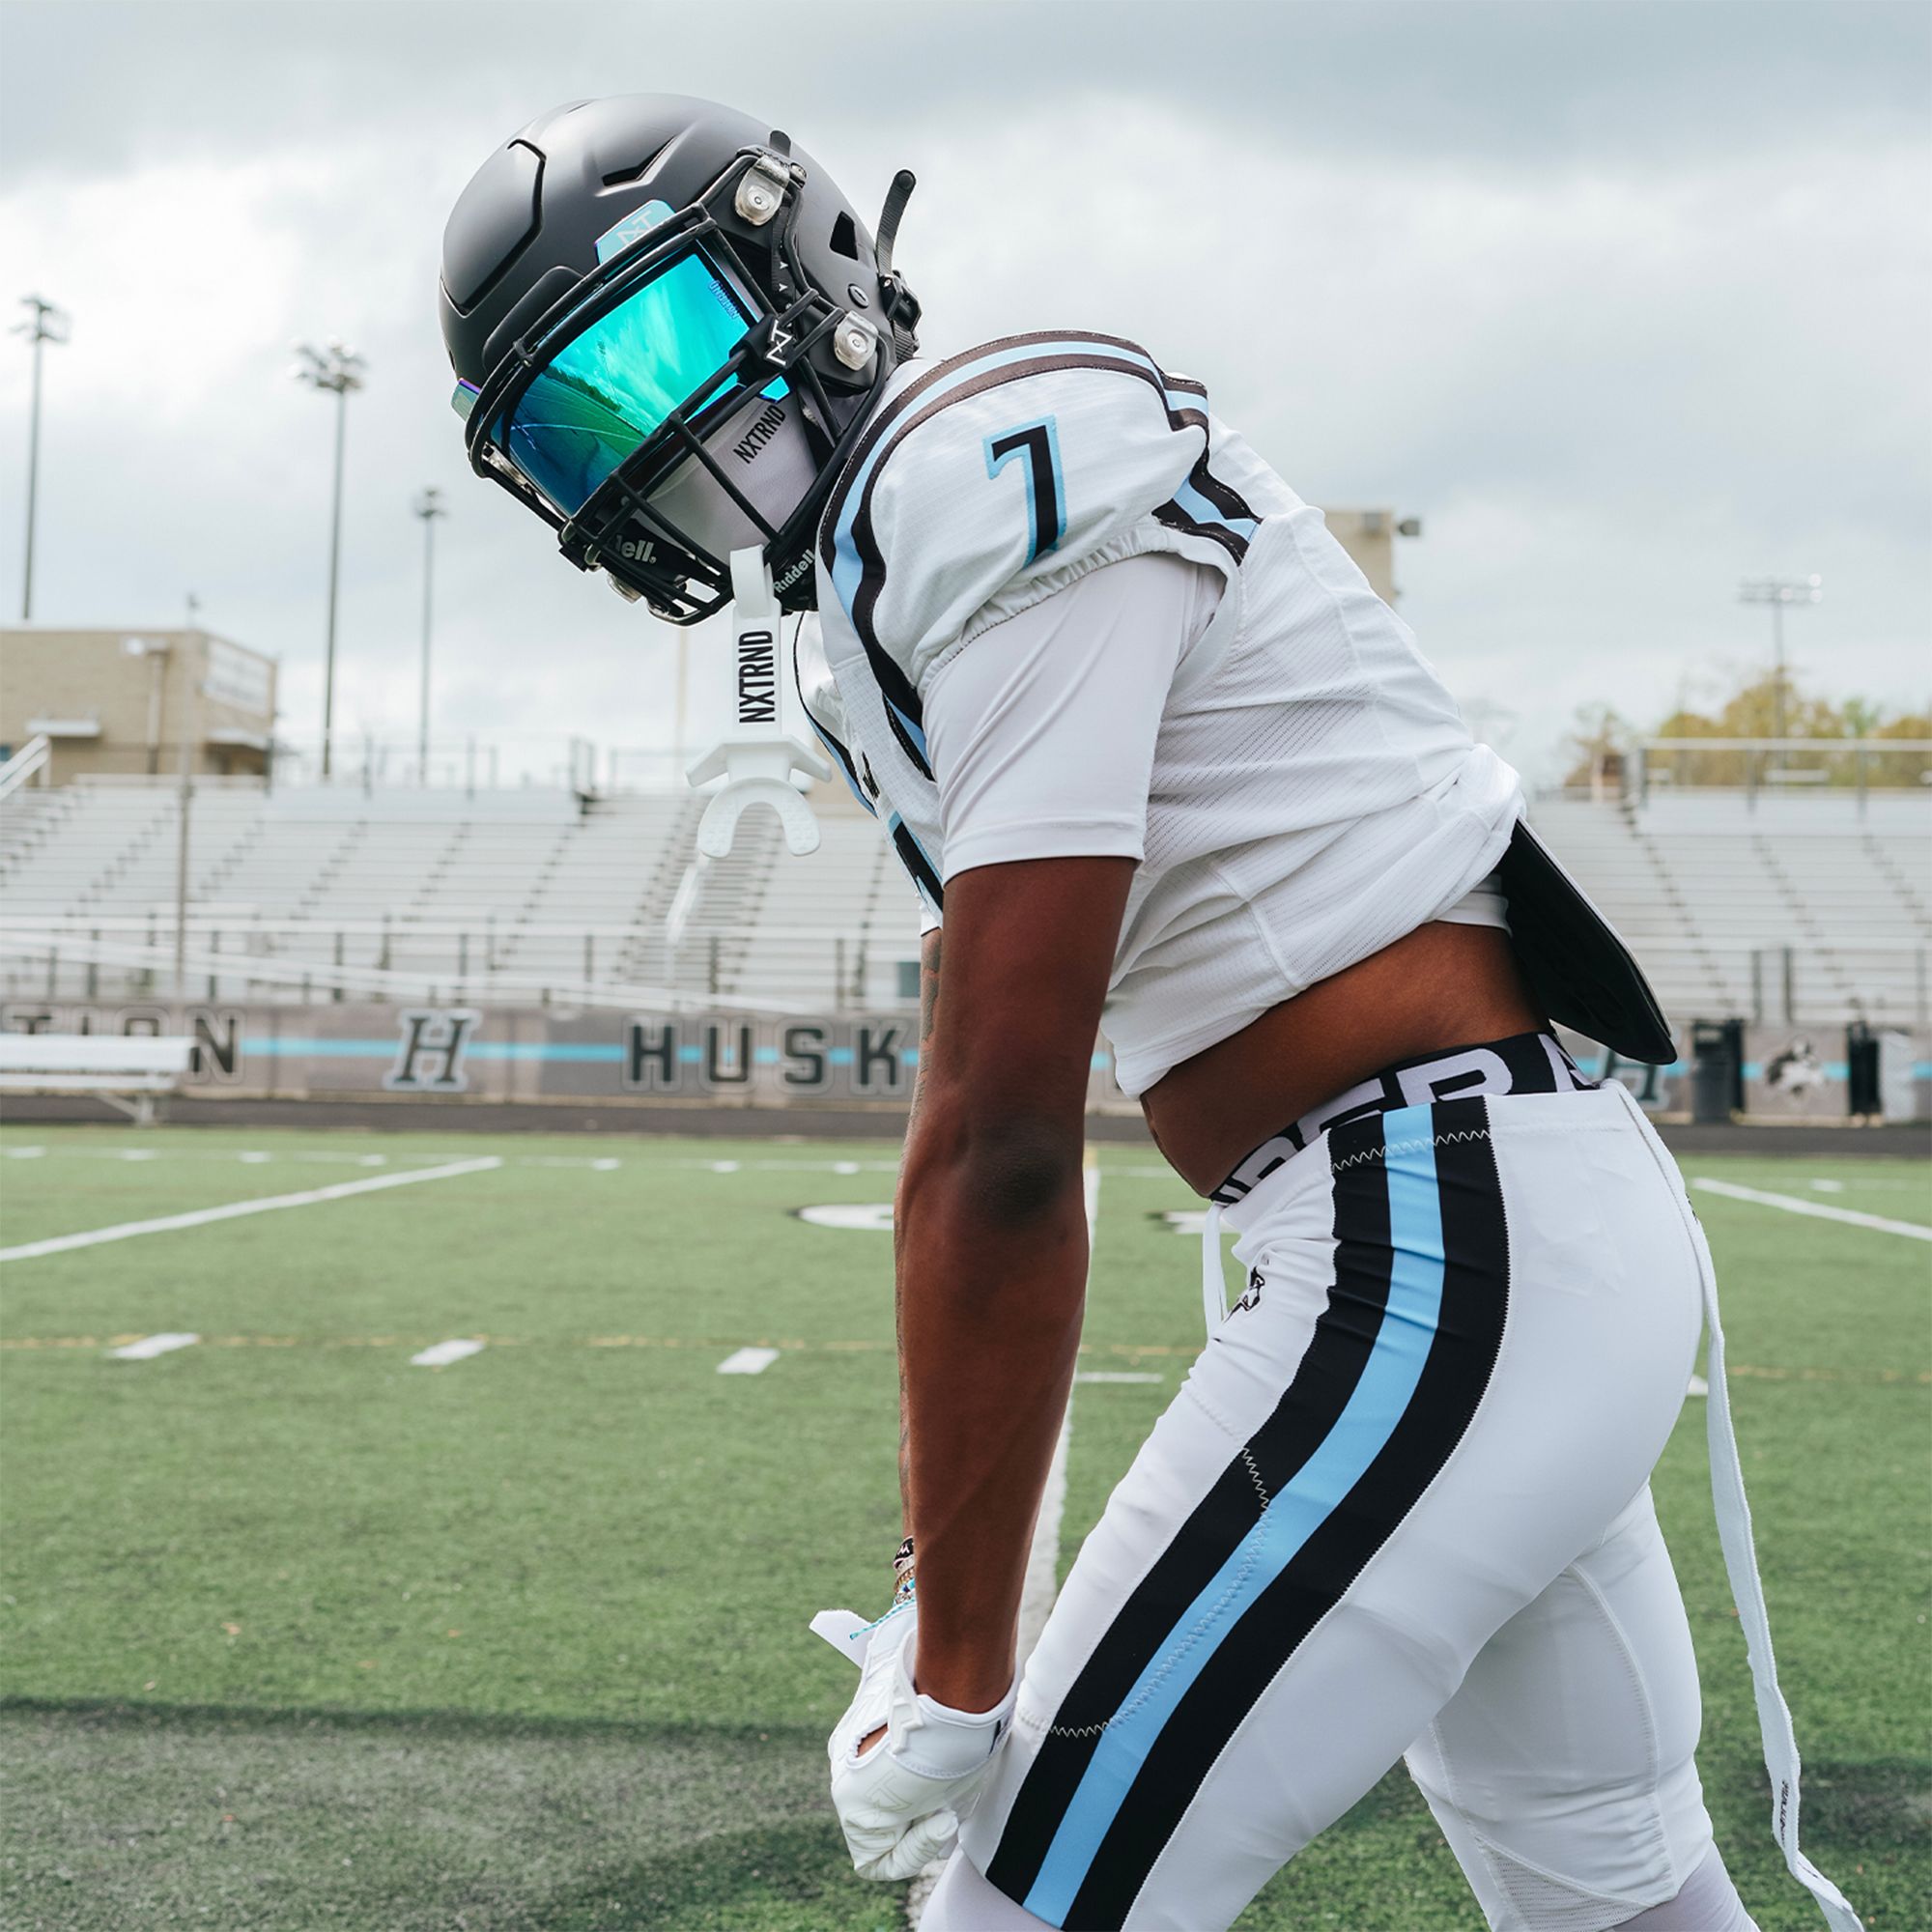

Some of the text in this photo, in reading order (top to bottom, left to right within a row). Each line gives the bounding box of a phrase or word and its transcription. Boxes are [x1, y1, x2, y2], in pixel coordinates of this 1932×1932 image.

[732, 404, 786, 465] NXTRND
[982, 413, 1067, 568] 7
[773, 549, 815, 594] Riddell
[738, 630, 776, 724] NXTRND
[386, 1011, 477, 1090] H
[628, 1020, 904, 1089] HUSK
